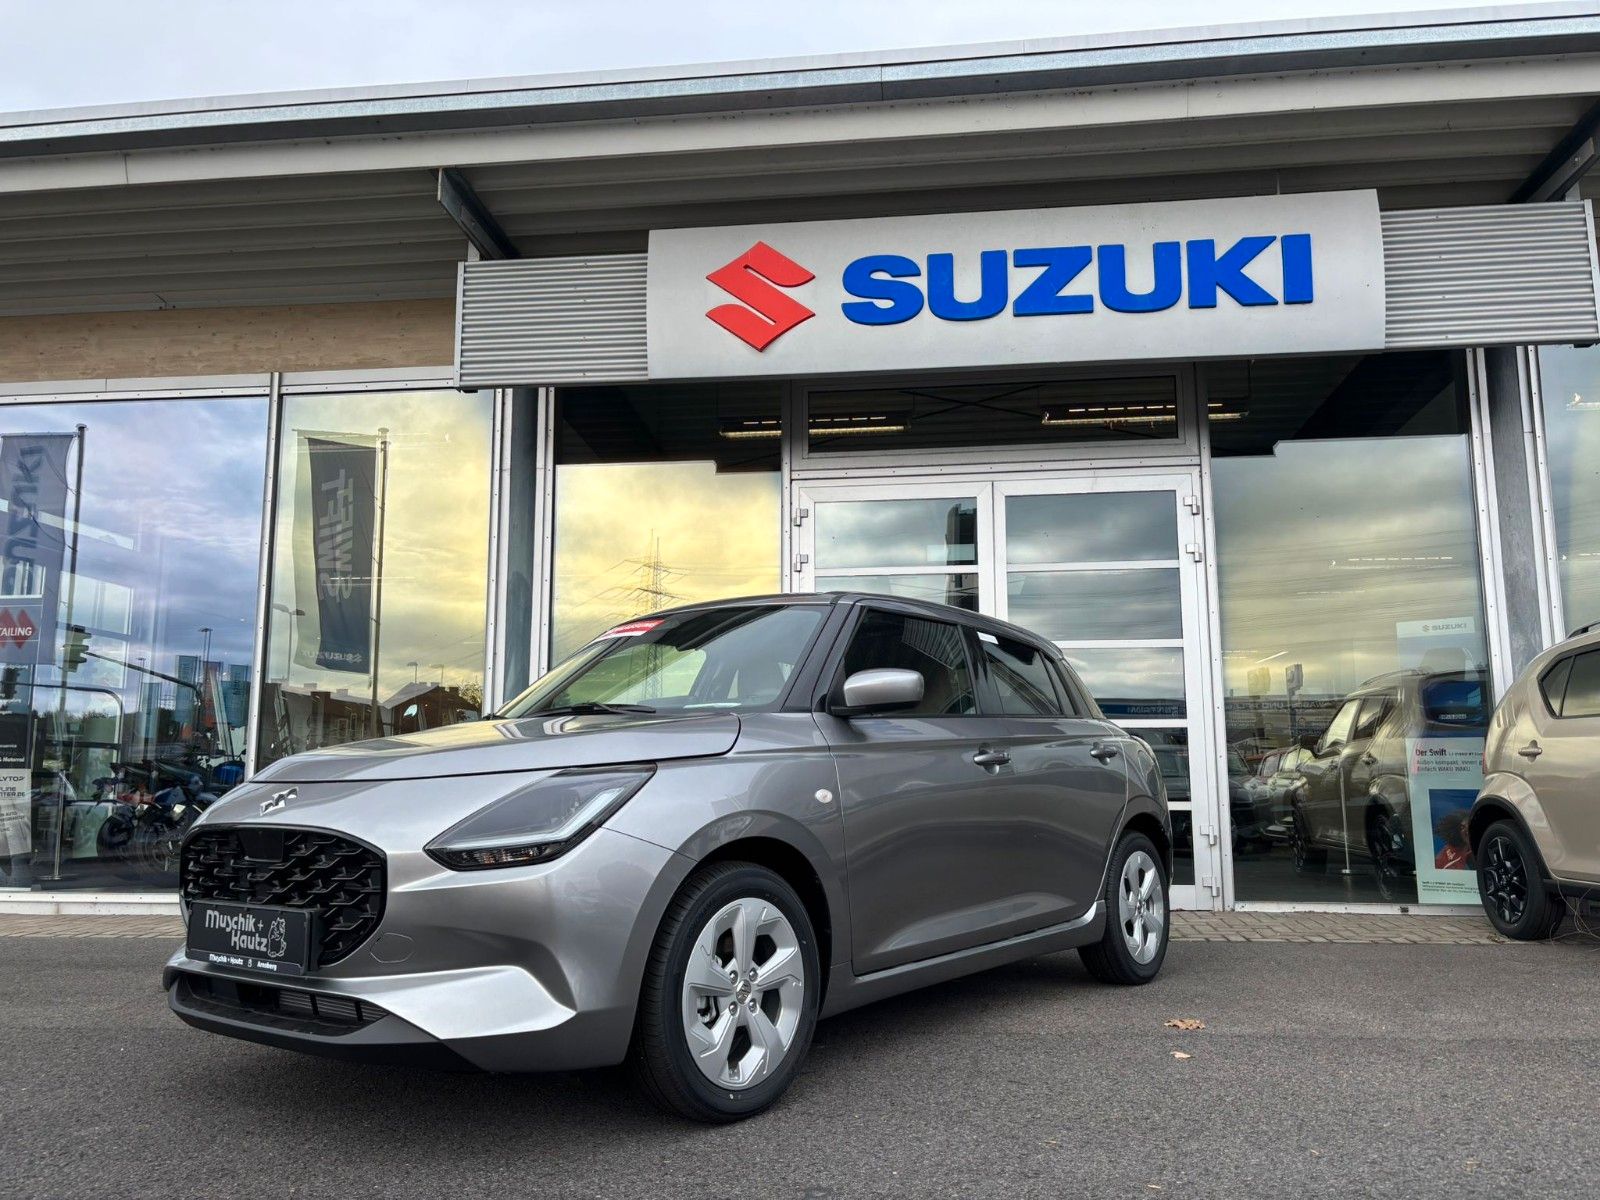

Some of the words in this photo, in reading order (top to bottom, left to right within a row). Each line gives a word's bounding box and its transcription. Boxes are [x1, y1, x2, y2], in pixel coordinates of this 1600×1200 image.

[841, 233, 1314, 326] SUZUKI
[1431, 623, 1467, 631] SUZUKI
[1416, 749, 1427, 757] Der
[1429, 748, 1447, 757] Swift
[205, 909, 255, 932] Muschik
[231, 931, 268, 952] Kautz
